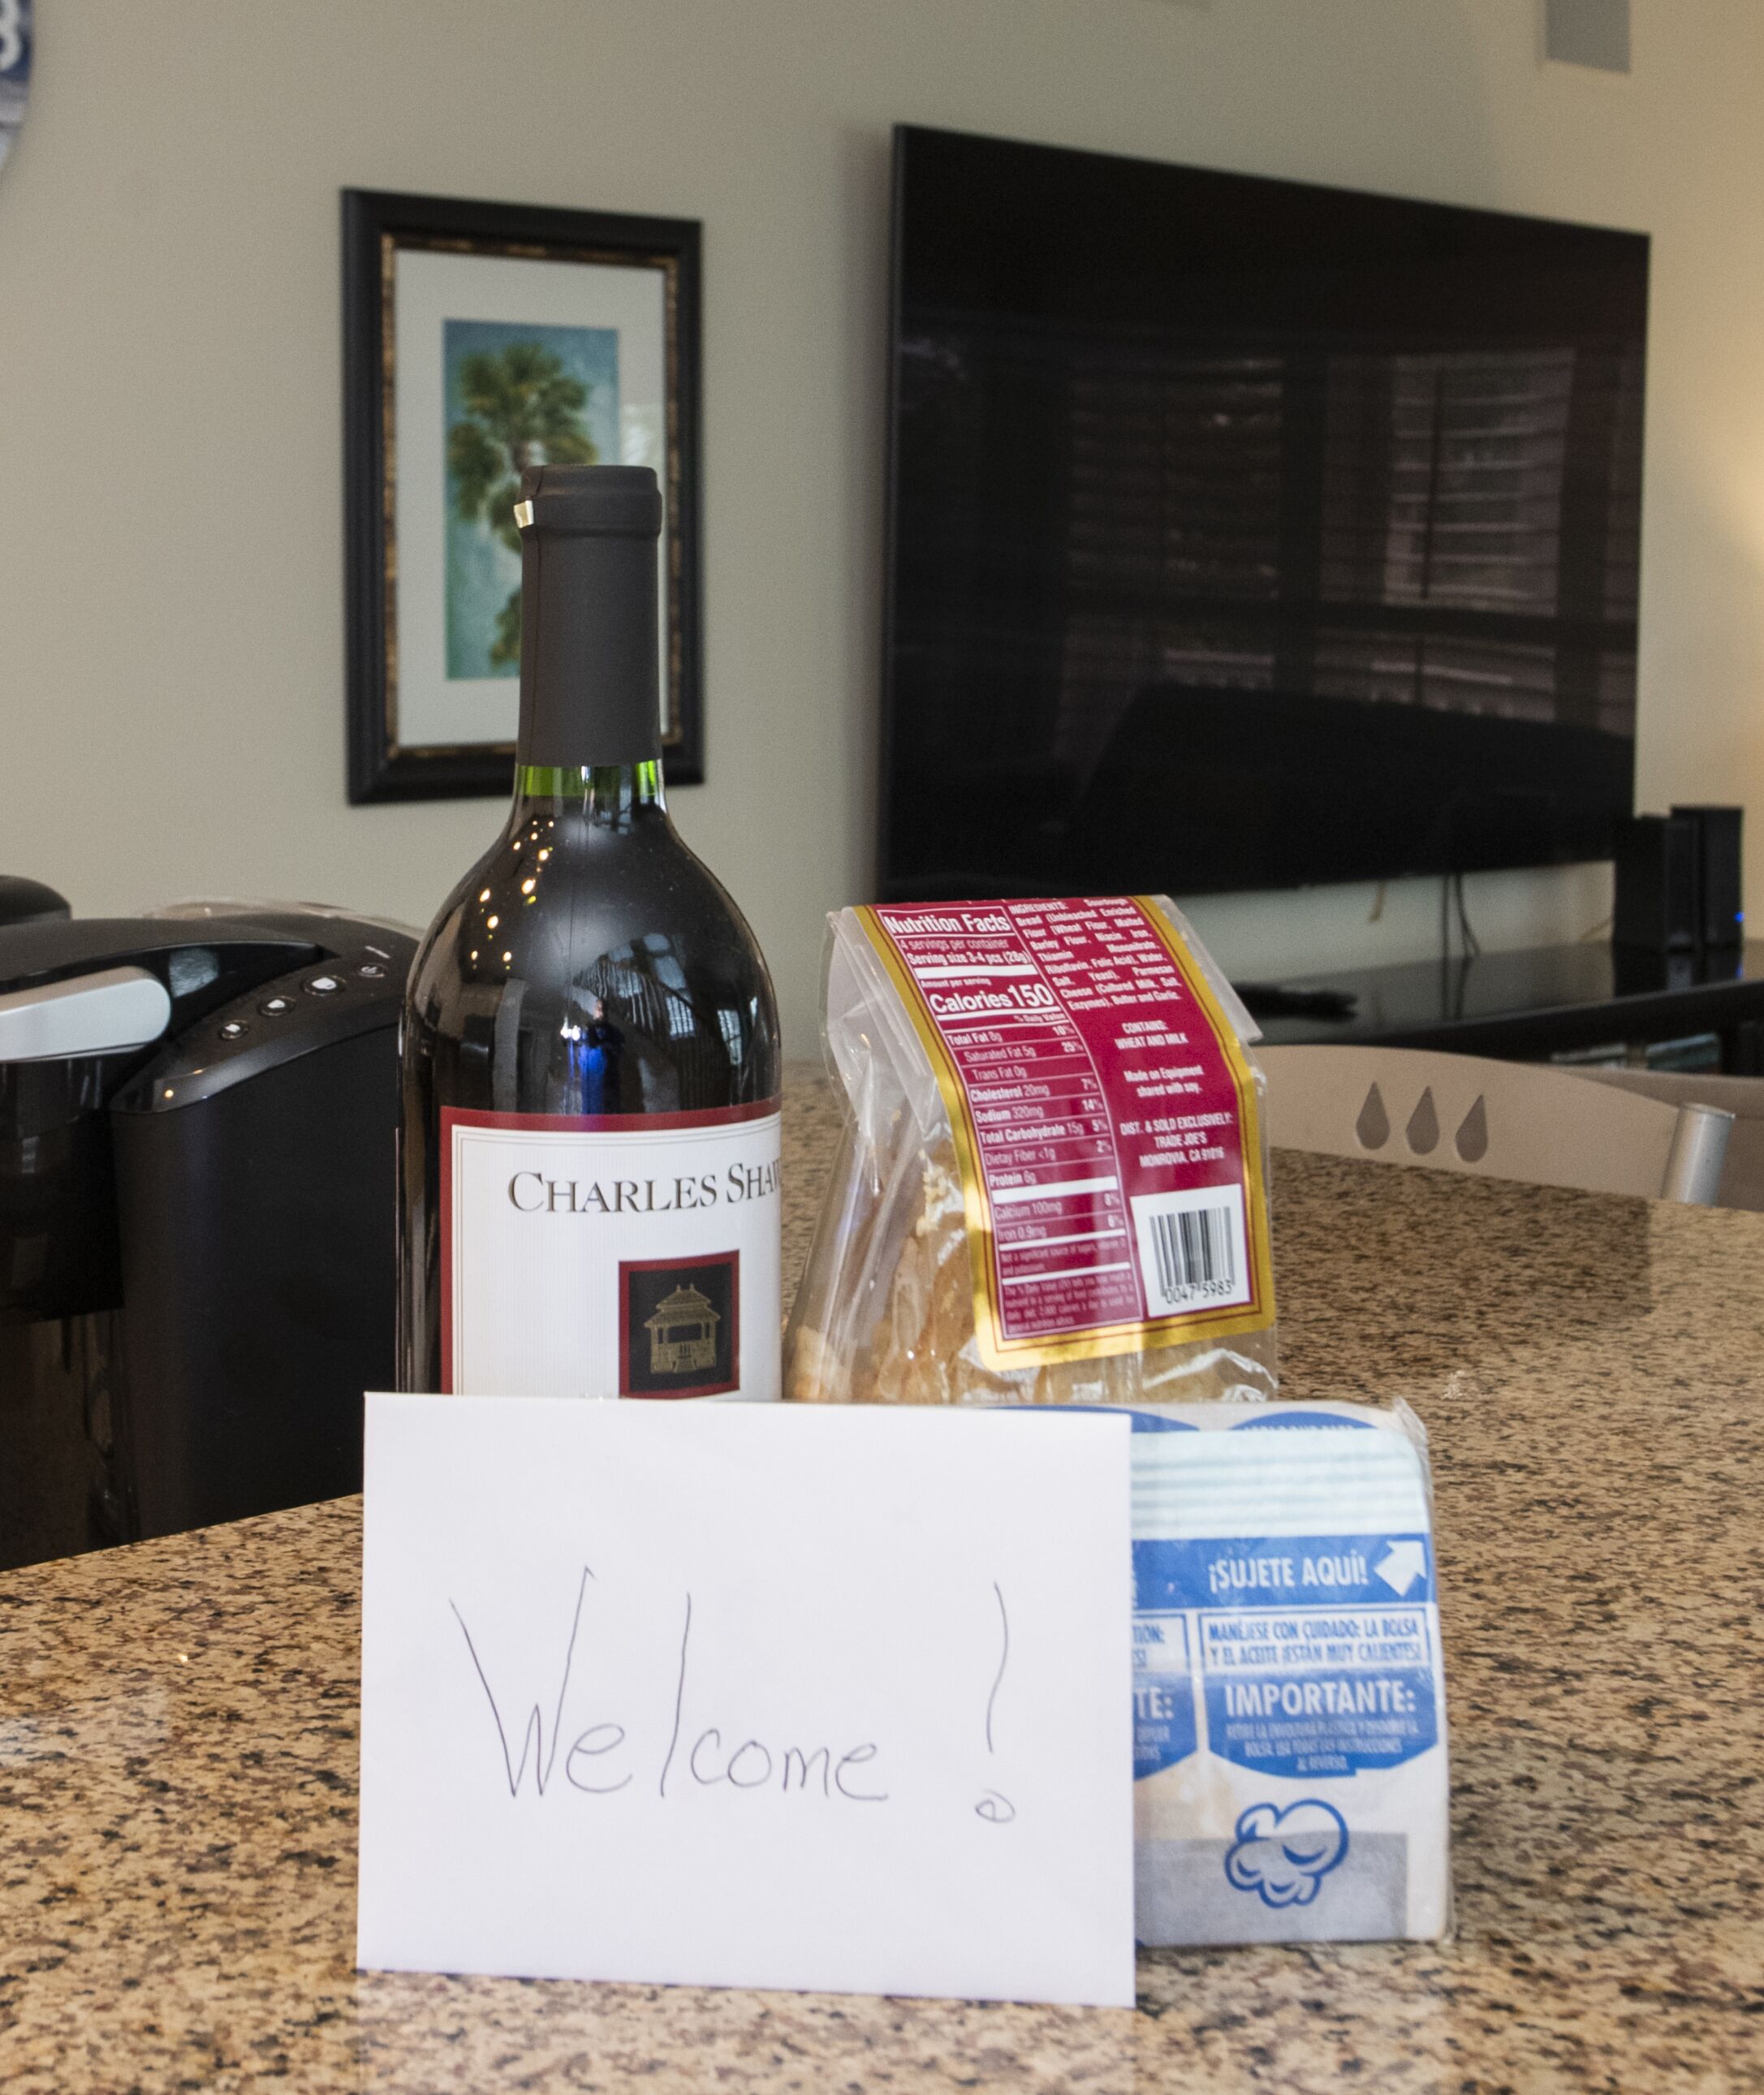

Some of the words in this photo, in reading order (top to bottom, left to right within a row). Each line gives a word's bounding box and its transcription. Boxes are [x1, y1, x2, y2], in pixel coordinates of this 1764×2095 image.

[883, 915, 962, 933] Nutrition
[961, 914, 1011, 932] Facts
[900, 940, 908, 950] 4
[908, 939, 950, 951] servings
[951, 940, 966, 951] per
[967, 938, 1009, 949] container
[1029, 939, 1059, 951] Barley
[907, 953, 948, 965] Serving
[947, 953, 965, 963] size
[966, 951, 985, 963] 3-4
[986, 953, 1002, 964] pcs
[1003, 951, 1032, 965] (28g)
[1037, 950, 1075, 962] Thiamin
[921, 979, 949, 988] Amount
[950, 979, 964, 989] per
[964, 977, 992, 987] serving
[929, 991, 1013, 1013] Calories
[1007, 983, 1055, 1007] 150
[947, 1034, 971, 1045] Total
[973, 1032, 989, 1043] Fat
[989, 1031, 1003, 1043] 8g
[1053, 1025, 1075, 1036] 10%
[1122, 1019, 1168, 1034] CONTAINS:
[1115, 1036, 1147, 1050] WHEAT
[1146, 1034, 1166, 1046] AND
[1164, 1032, 1188, 1045] MILK
[964, 1049, 1007, 1063] Saturated
[1007, 1047, 1022, 1058] Fat
[1022, 1045, 1037, 1058] 5g
[1061, 1041, 1084, 1053] 25%
[972, 1069, 998, 1080] Trans
[998, 1067, 1014, 1079] Fat
[1013, 1065, 1027, 1078] 0g
[1124, 1070, 1149, 1082] Made
[1149, 1070, 1161, 1080] on
[1159, 1065, 1205, 1080] Equipment
[970, 1086, 1023, 1102] Cholesterol
[1023, 1084, 1050, 1097] 20mg
[1081, 1078, 1098, 1090] 7%
[1136, 1084, 1166, 1097] shared
[1165, 1082, 1184, 1094] with
[975, 1109, 1011, 1123] Sodium
[1011, 1106, 1044, 1119] 320mg
[1082, 1099, 1103, 1111] 14%
[981, 1132, 1003, 1144] Total
[1006, 1125, 1066, 1141] Carbohydrate
[1067, 1122, 1085, 1136] 15g
[1091, 1119, 1108, 1132] 5%
[1119, 1121, 1144, 1136] DIST.
[1153, 1118, 1177, 1132] SOLD
[1154, 1135, 1184, 1149] TRADE
[1016, 1149, 1036, 1162] Fiber
[1038, 1147, 1055, 1160] <1g
[1188, 1149, 1201, 1162] CA
[990, 1172, 1024, 1187] Protein
[508, 1170, 718, 1213] CHARLES
[995, 1205, 1030, 1219] Calcium
[1032, 1201, 1063, 1214] 100mg
[998, 1228, 1016, 1241] Iron
[1208, 1558, 1295, 1594] ¡SUJETE
[1302, 1549, 1369, 1586] AQUÍ!
[1273, 1621, 1298, 1639] CON
[1364, 1619, 1379, 1636] LA
[1382, 1619, 1419, 1636] BOLSA
[449, 1566, 889, 1800] Welcome
[1224, 1680, 1417, 1717] IMPORTANTE:
